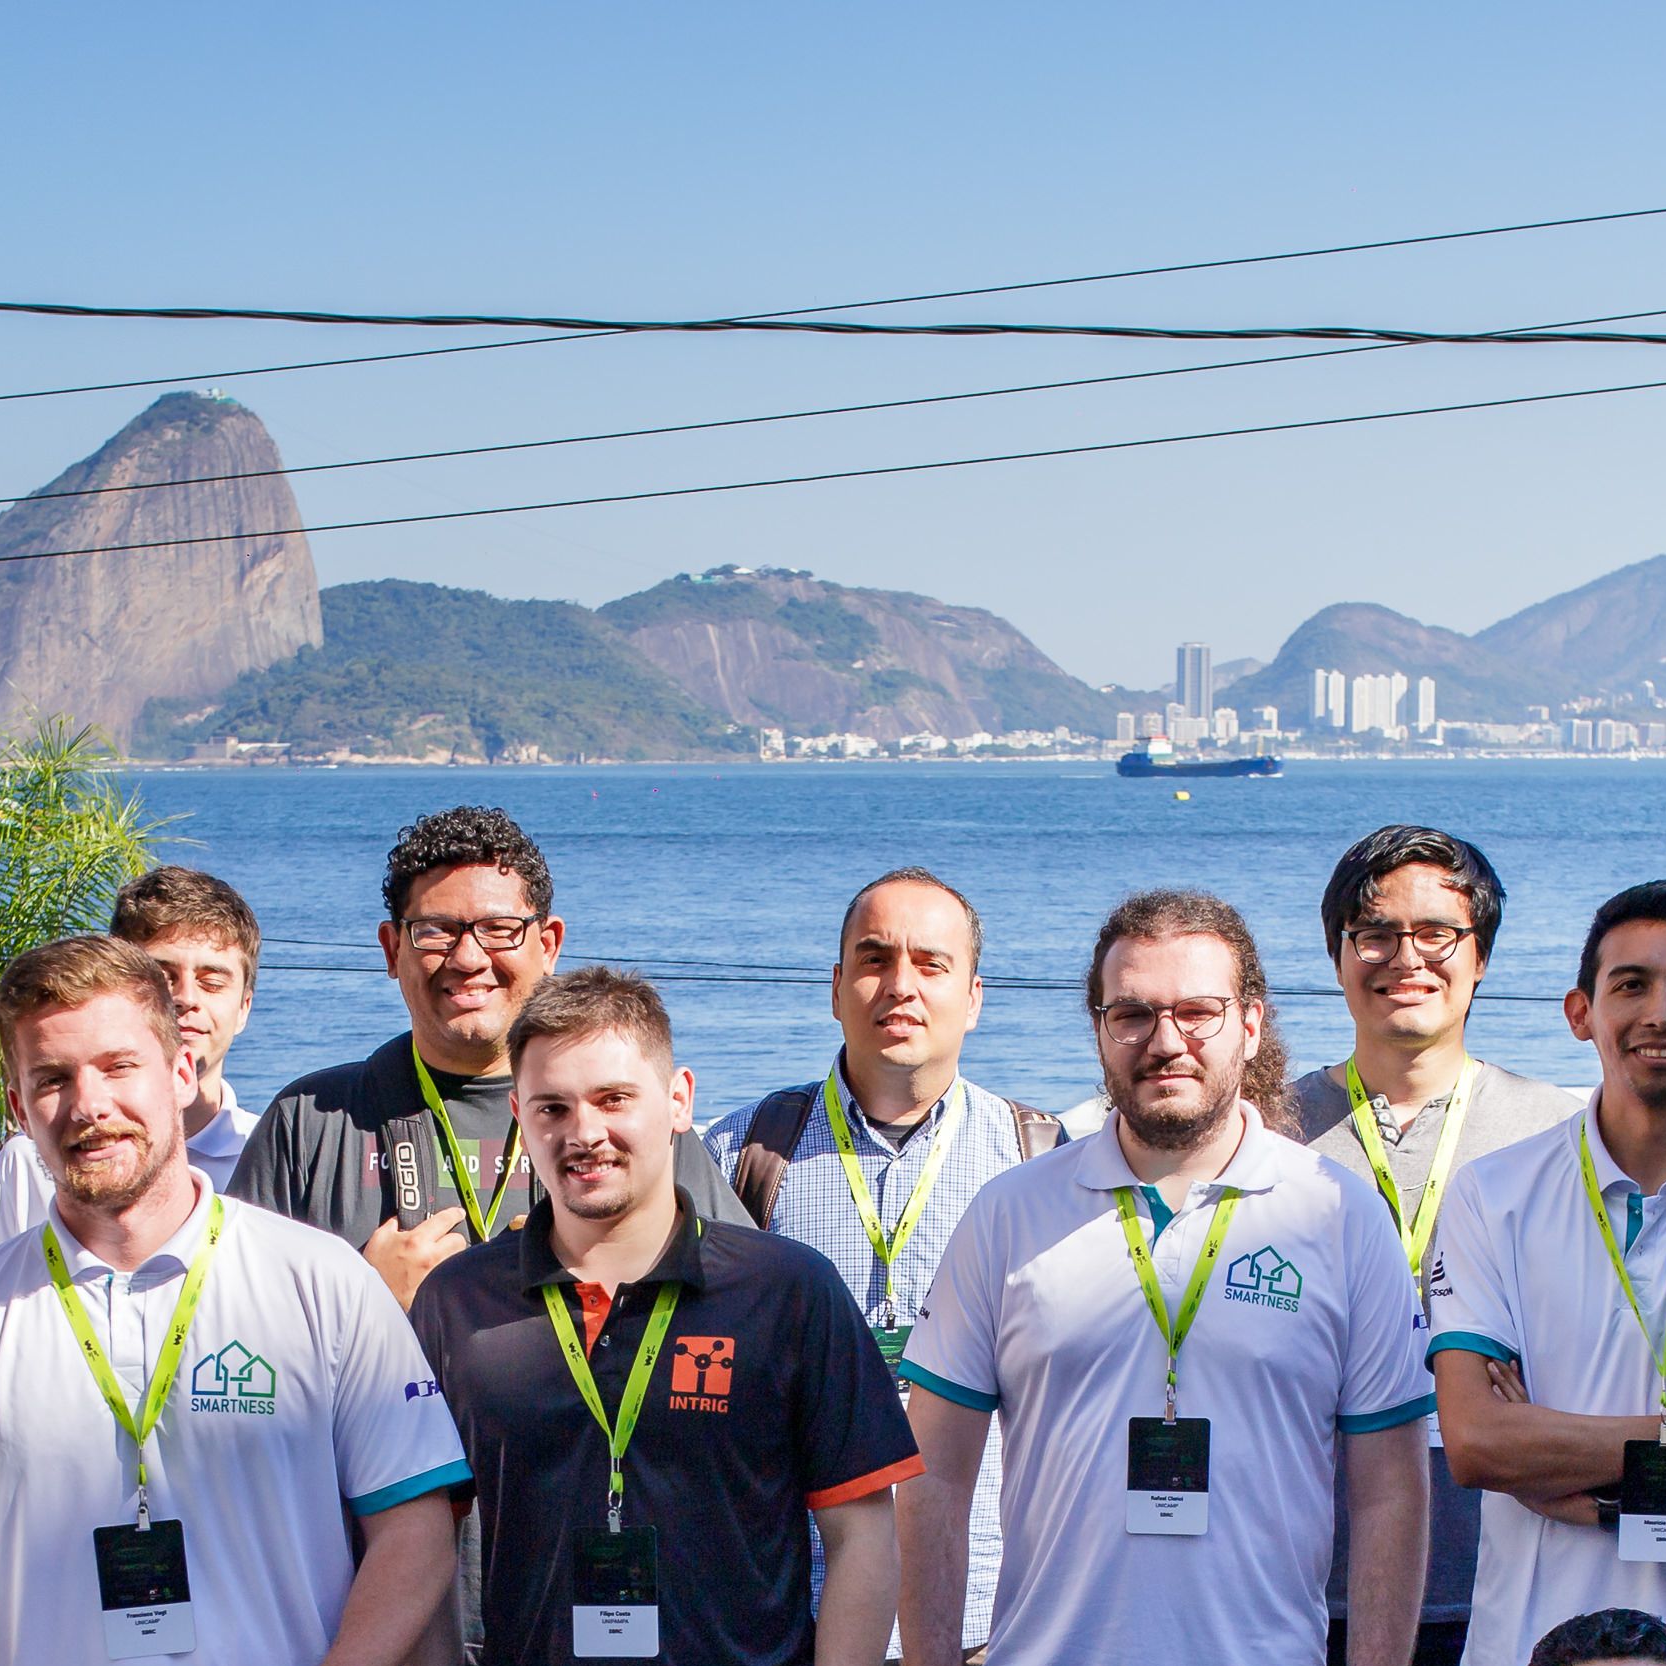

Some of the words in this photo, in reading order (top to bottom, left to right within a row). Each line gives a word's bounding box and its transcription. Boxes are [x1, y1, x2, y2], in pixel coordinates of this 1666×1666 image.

[442, 1154, 480, 1173] AD
[395, 1141, 421, 1211] OGIO
[1224, 1288, 1300, 1313] SMARTNESS
[191, 1397, 276, 1416] SMARTNESS
[669, 1395, 730, 1414] INTRIG
